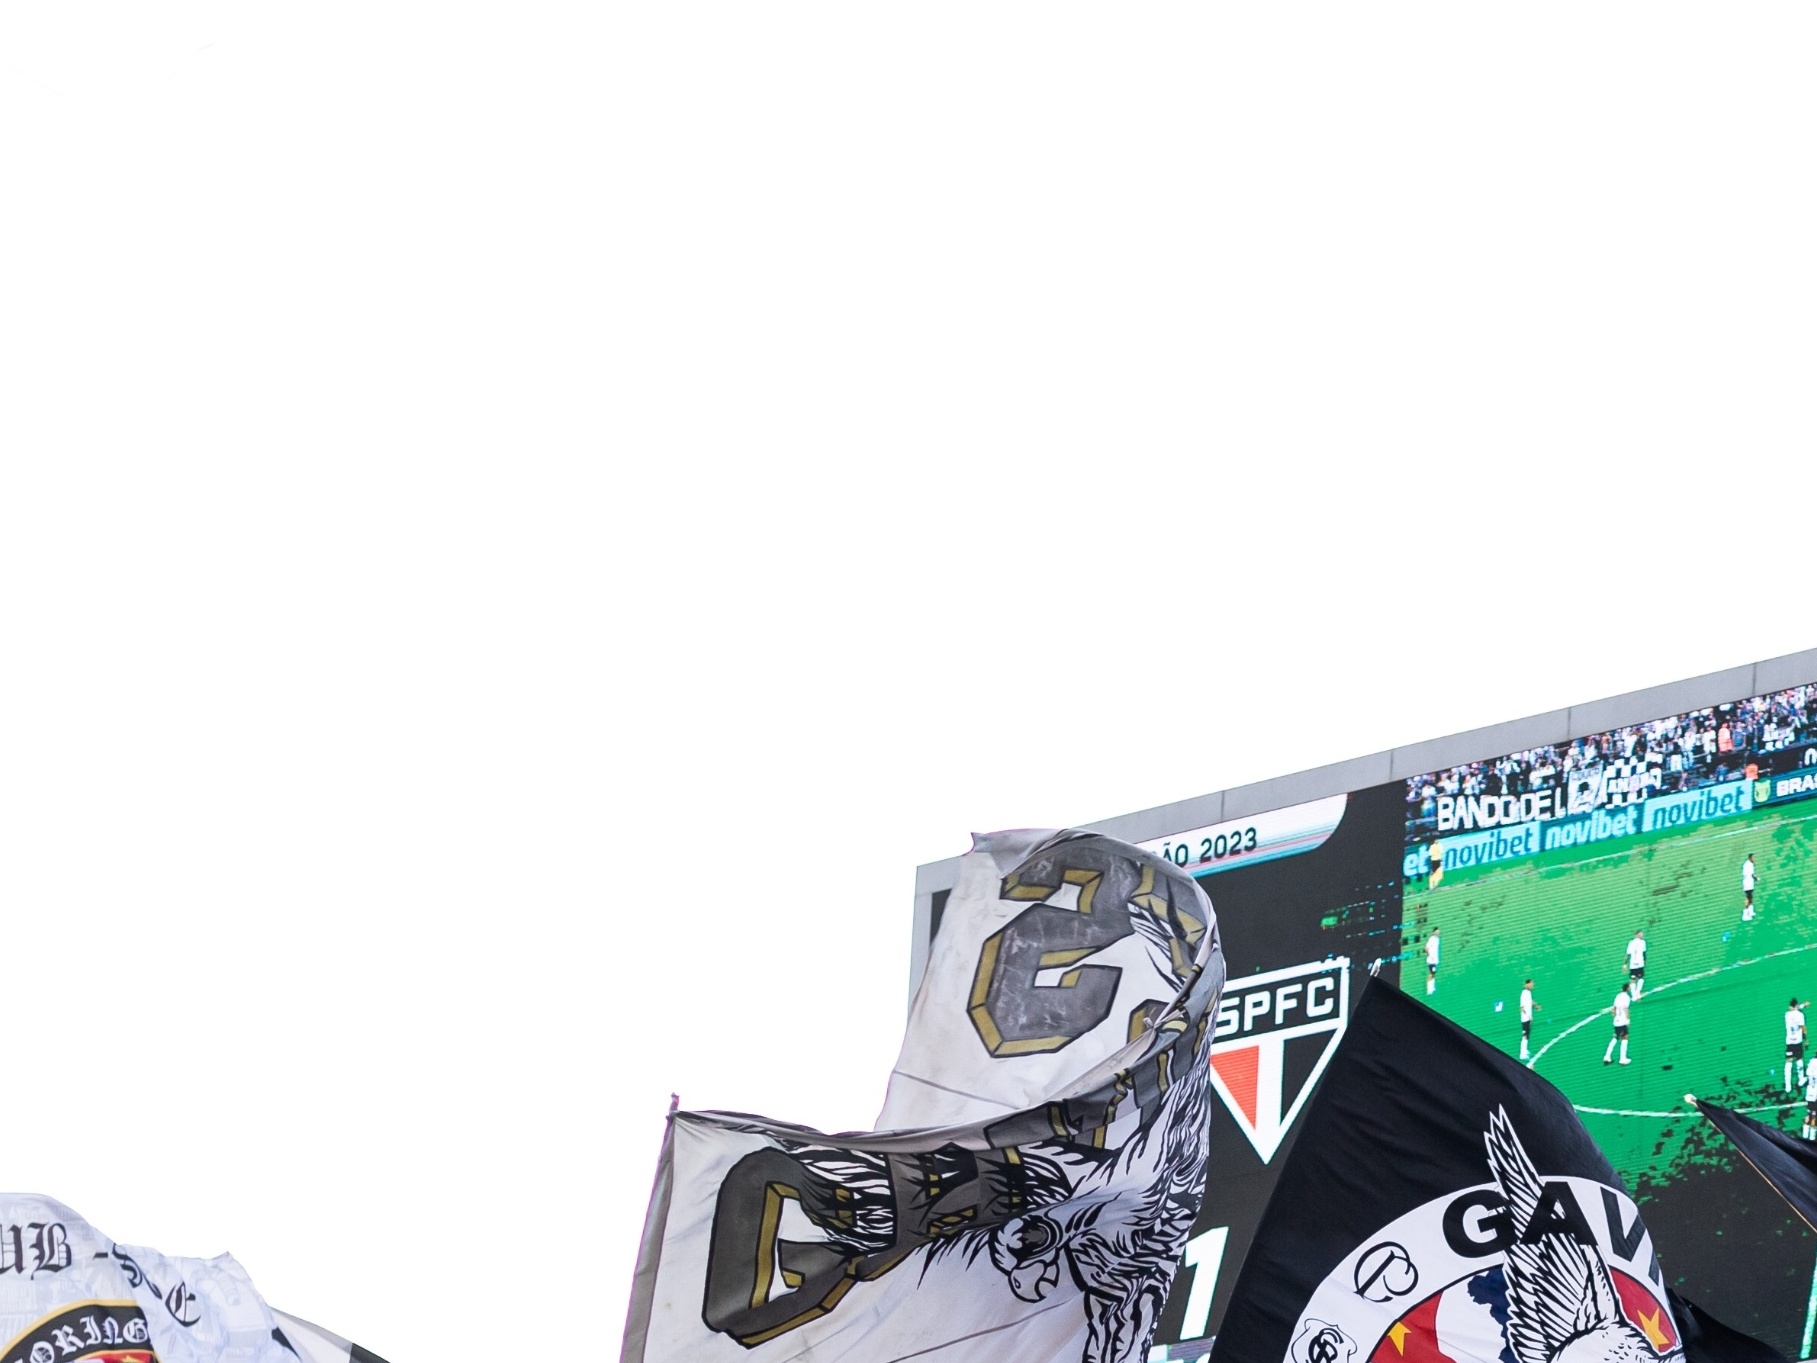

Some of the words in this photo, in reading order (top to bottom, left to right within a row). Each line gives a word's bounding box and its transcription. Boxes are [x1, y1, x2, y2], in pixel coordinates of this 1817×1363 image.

[1162, 841, 1190, 869] ÃO
[1200, 826, 1257, 864] 2023
[1443, 829, 1534, 867] novibet
[1545, 811, 1638, 849] novibet
[1653, 787, 1746, 829] novibet
[1213, 976, 1335, 1038] SPFC
[0, 1221, 72, 1280] UB
[1442, 1180, 1661, 1284] GAV
[1179, 1225, 1230, 1341] 1
